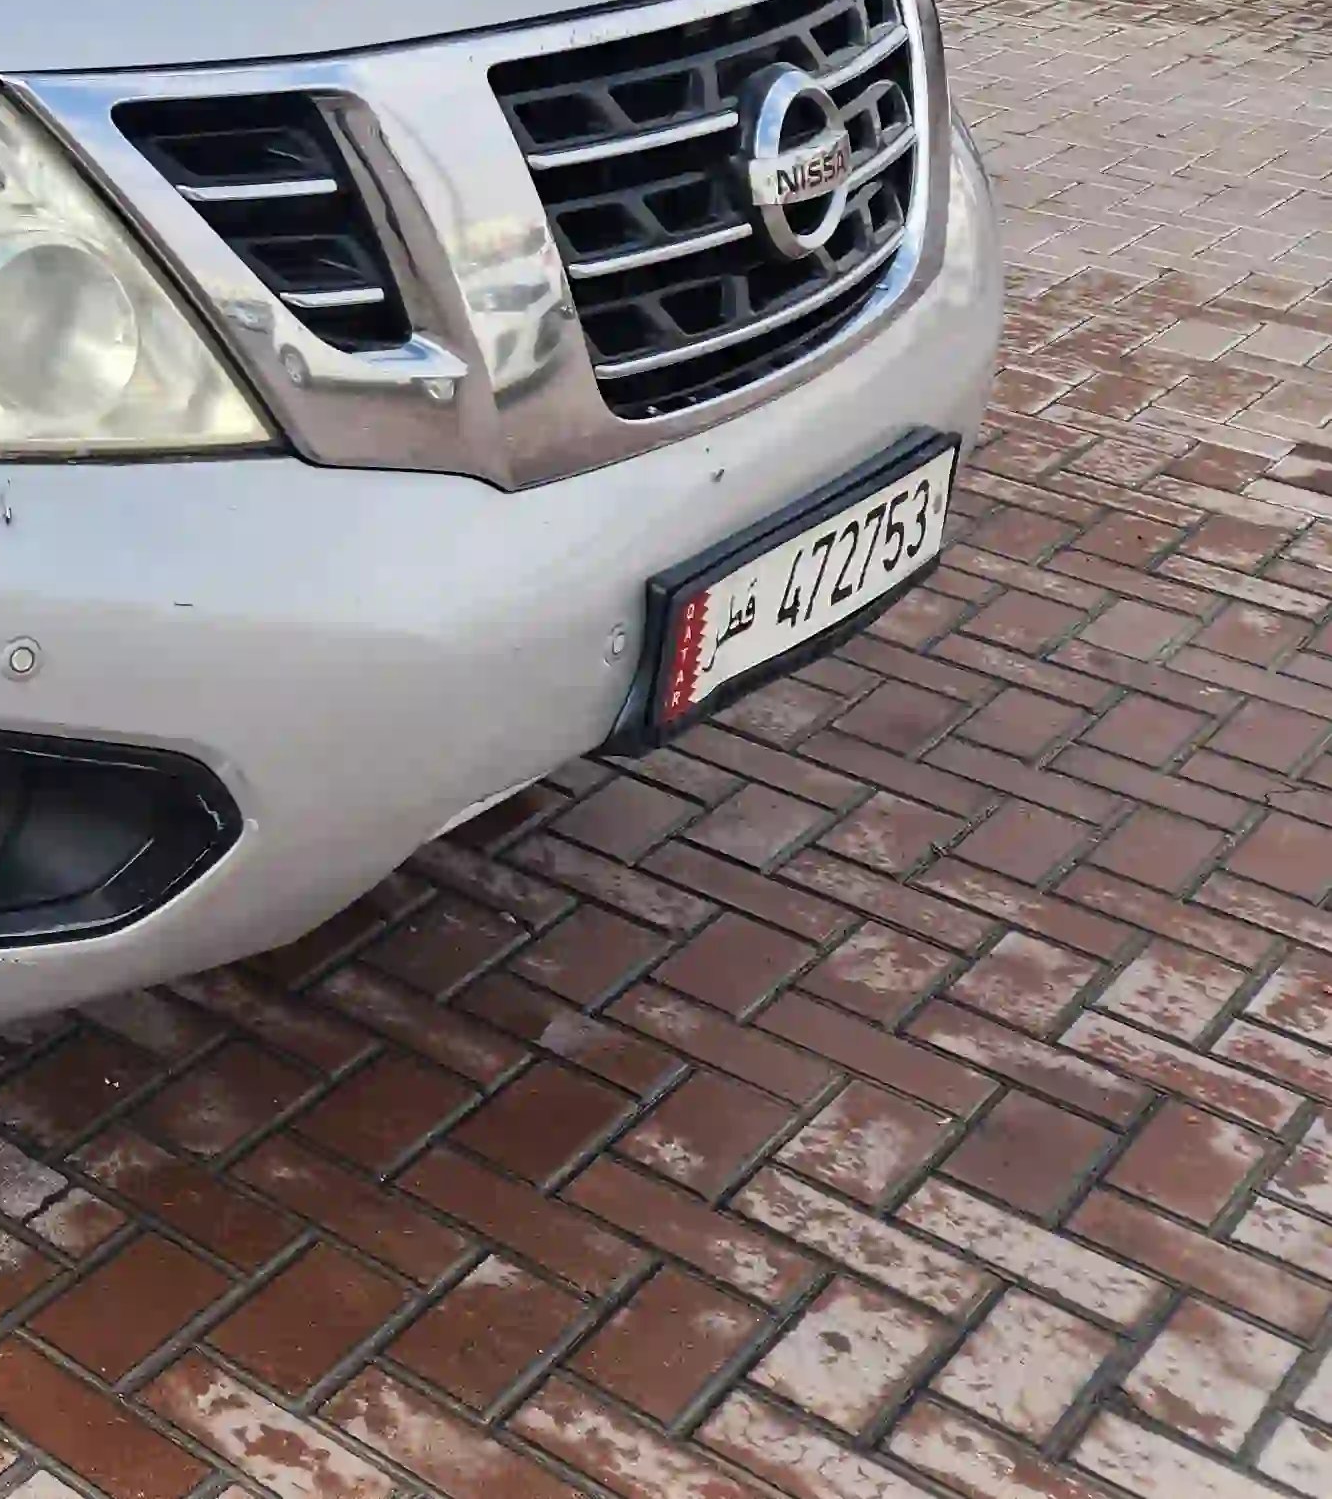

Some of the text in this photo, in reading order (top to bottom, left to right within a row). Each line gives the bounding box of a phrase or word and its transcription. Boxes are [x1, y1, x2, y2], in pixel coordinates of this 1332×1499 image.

[775, 150, 849, 197] NISSA
[775, 478, 930, 629] 472753
[671, 602, 696, 708] QATAR
[701, 577, 757, 673] قطر
